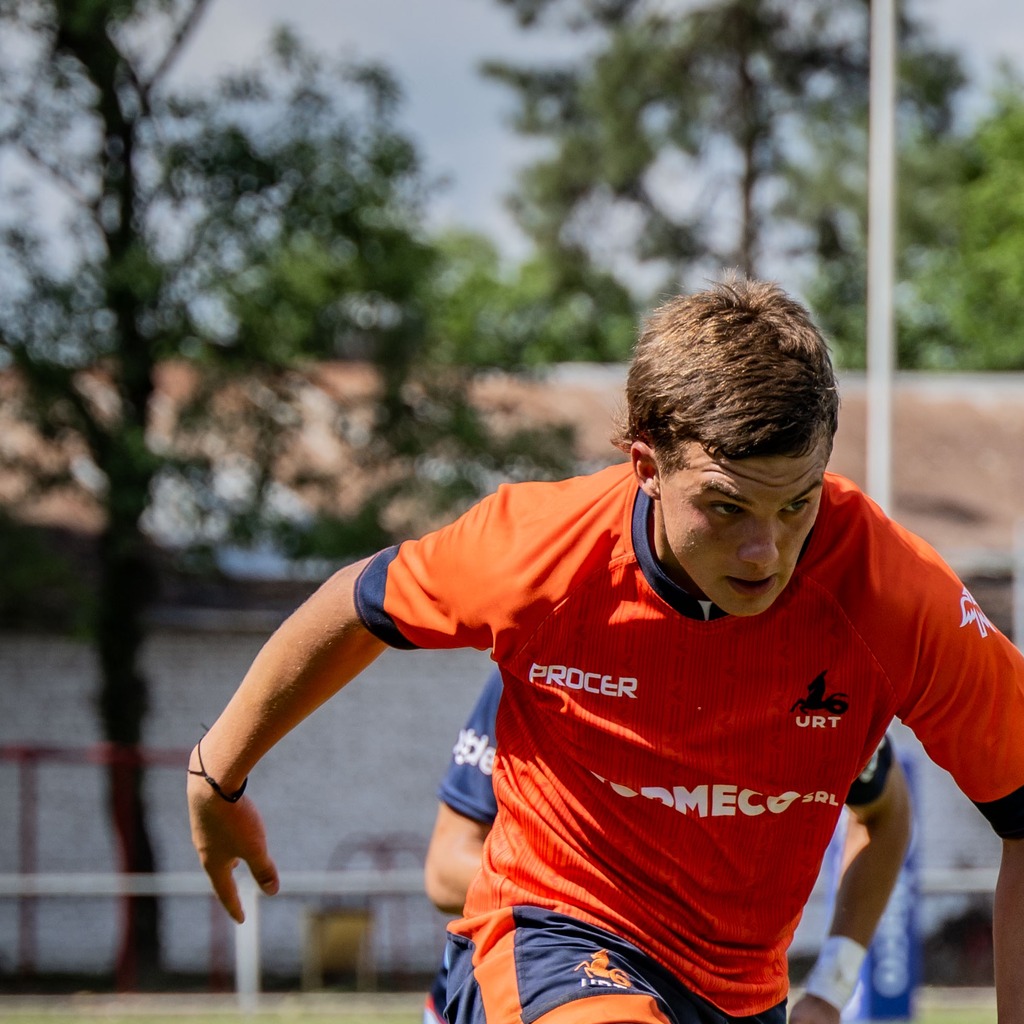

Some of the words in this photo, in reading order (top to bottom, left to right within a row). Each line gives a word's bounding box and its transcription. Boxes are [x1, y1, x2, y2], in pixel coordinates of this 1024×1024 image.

[529, 662, 638, 699] PROCER
[795, 715, 841, 728] URT
[801, 790, 839, 806] SRL
